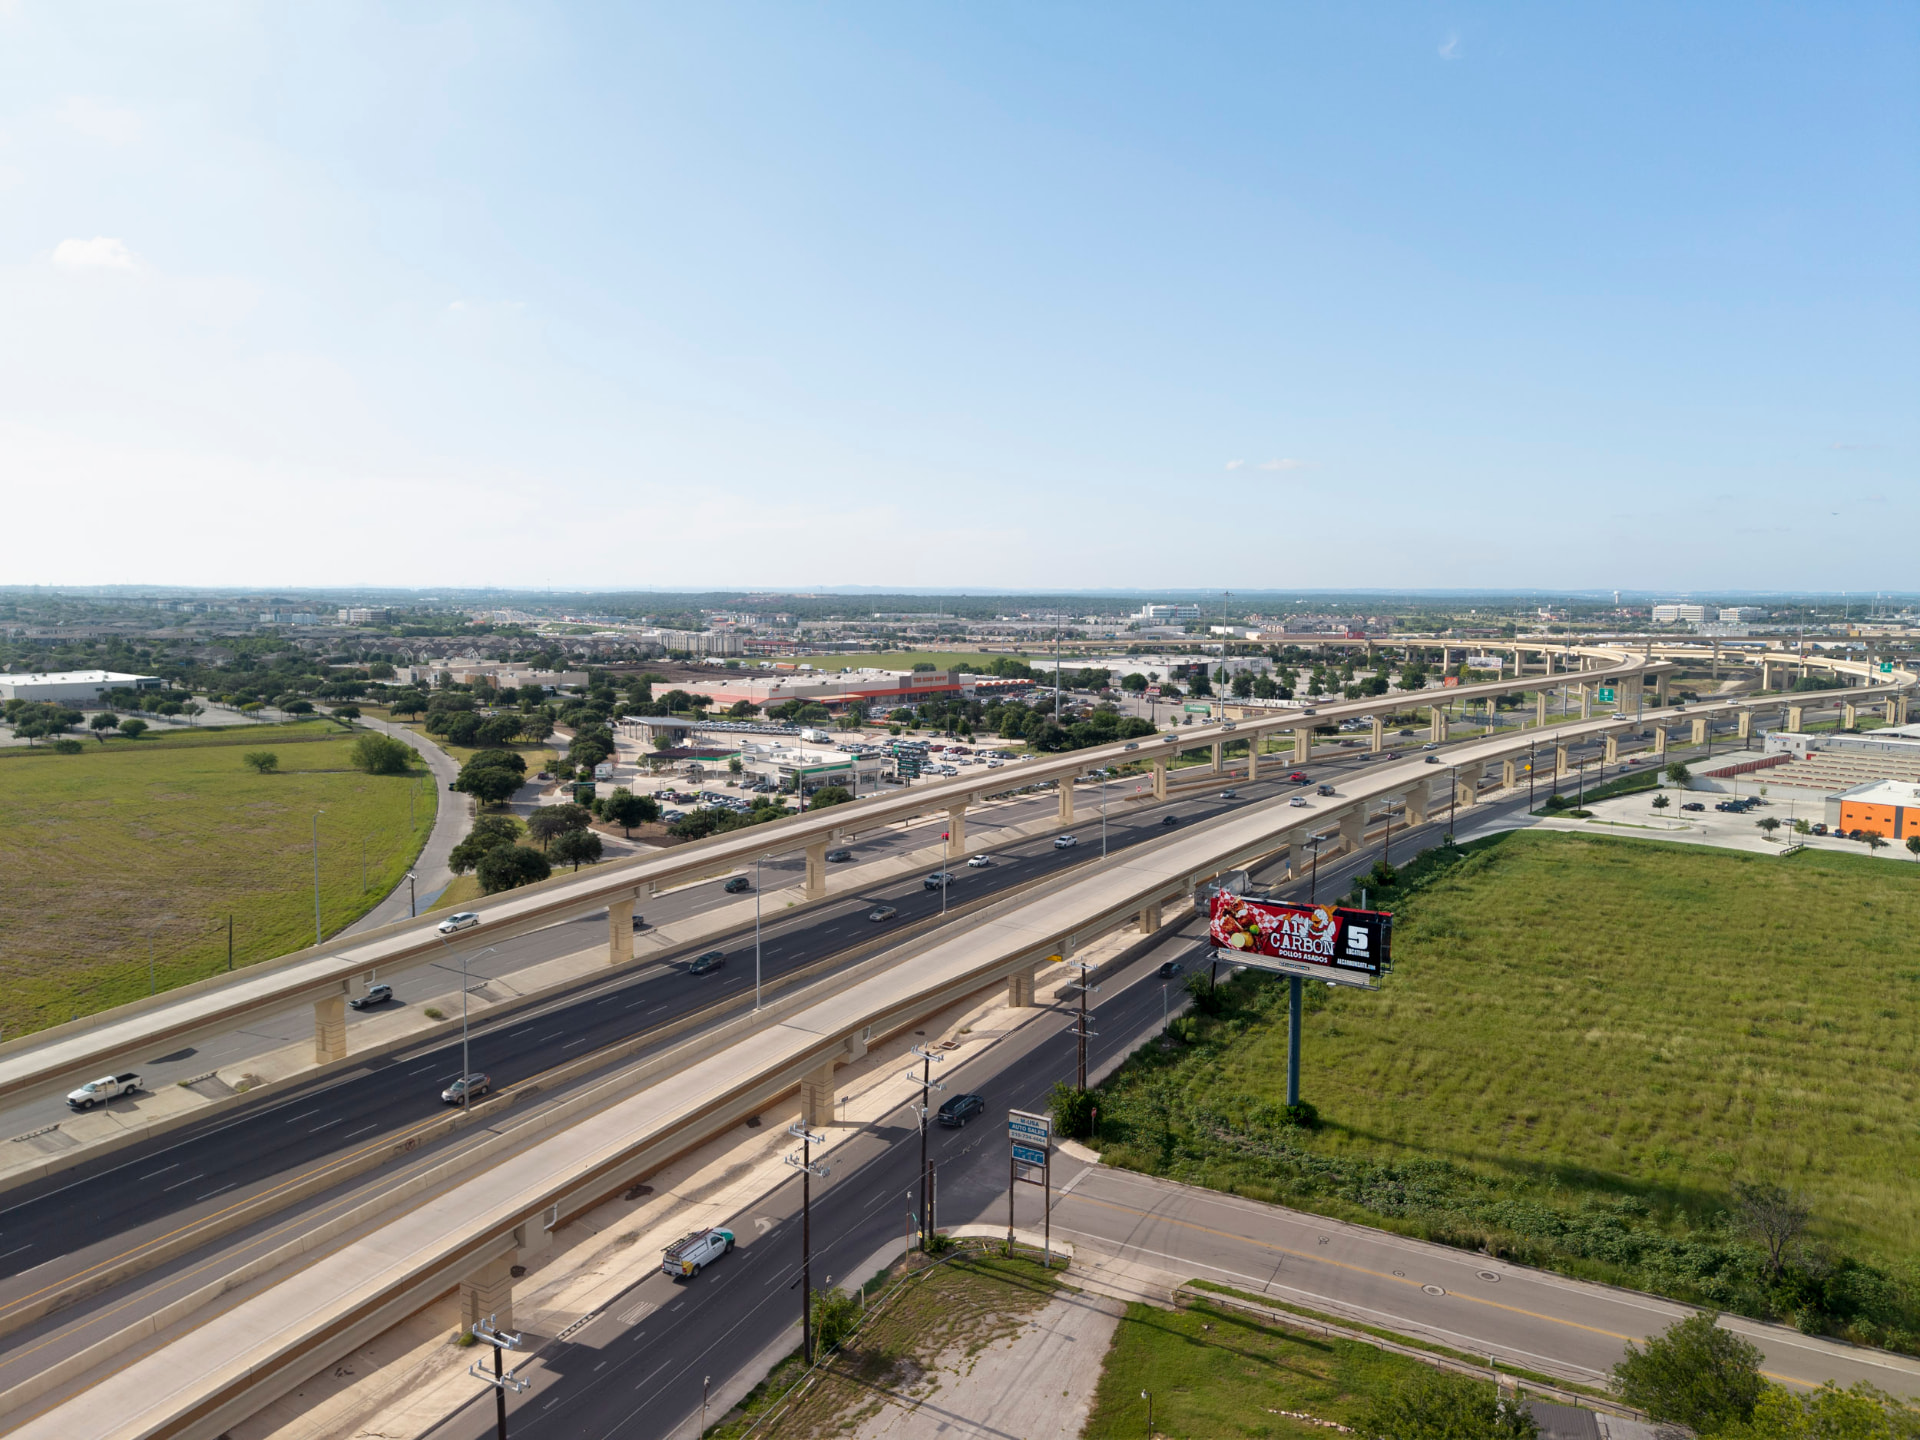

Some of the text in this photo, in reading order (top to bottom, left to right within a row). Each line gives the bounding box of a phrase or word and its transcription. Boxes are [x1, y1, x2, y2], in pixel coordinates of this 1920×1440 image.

[1270, 933, 1335, 956] CARBON
[1348, 925, 1369, 950] 5
[1278, 949, 1328, 963] POLLOS ASADOS
[1345, 947, 1370, 958] LOCATIONS
[1011, 1123, 1045, 1136] AUTO SALES
